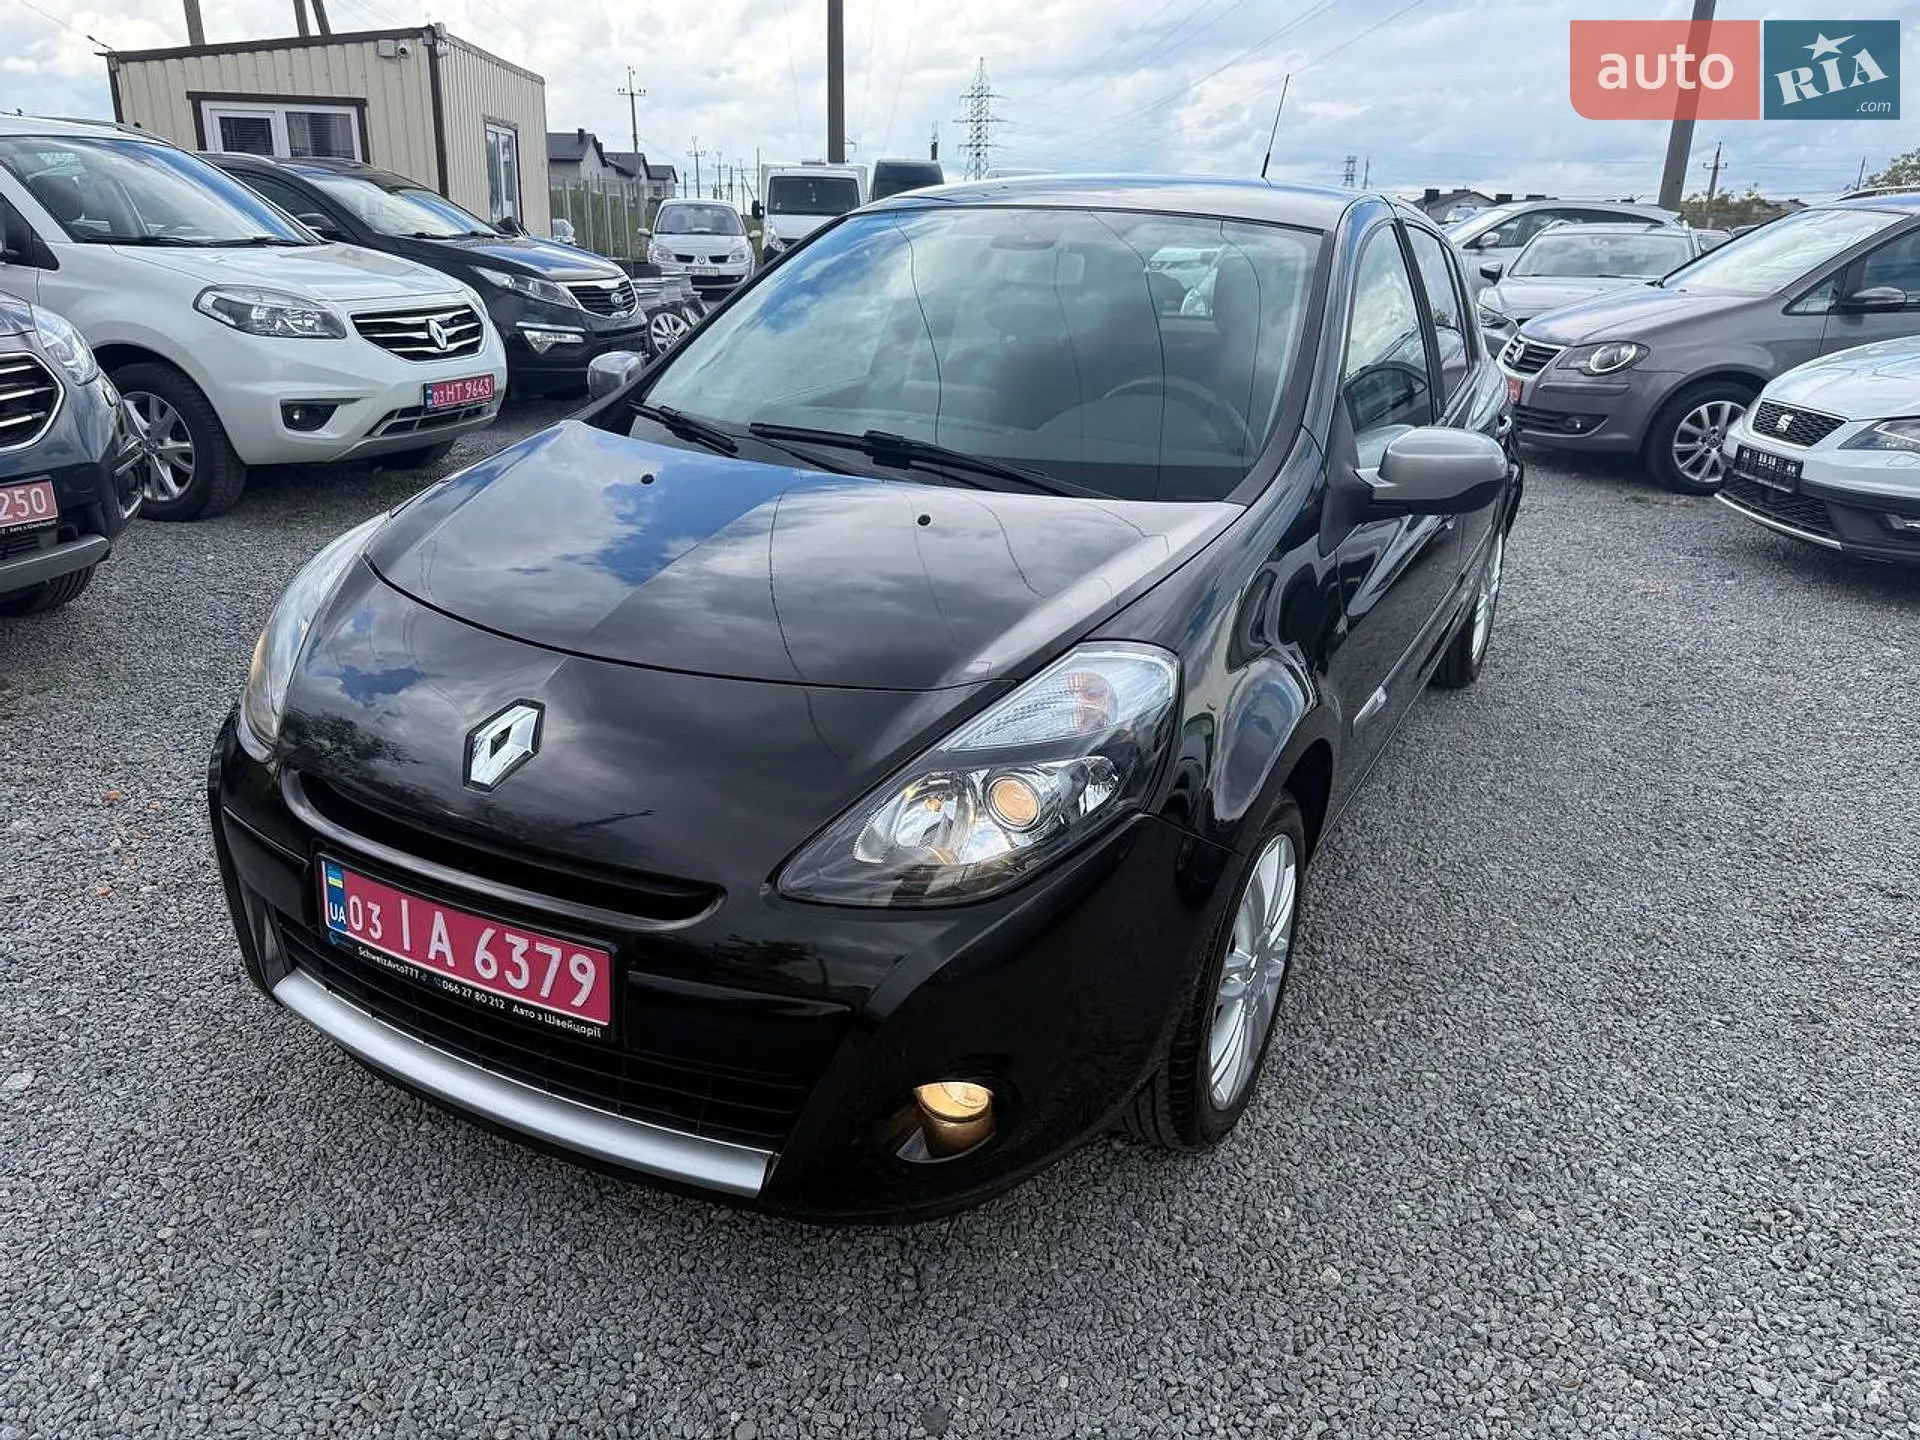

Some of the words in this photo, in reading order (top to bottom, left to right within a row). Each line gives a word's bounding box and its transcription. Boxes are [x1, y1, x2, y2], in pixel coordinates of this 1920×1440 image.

[433, 391, 445, 405] 03
[446, 383, 463, 401] HT
[465, 378, 490, 399] 9643
[329, 903, 347, 924] UA
[349, 895, 383, 940] 03
[401, 898, 455, 967] IA
[474, 928, 597, 1008] 6379
[442, 980, 461, 995] 066
[461, 987, 473, 999] 27
[489, 996, 506, 1010] 212
[512, 1004, 536, 1019] Авто
